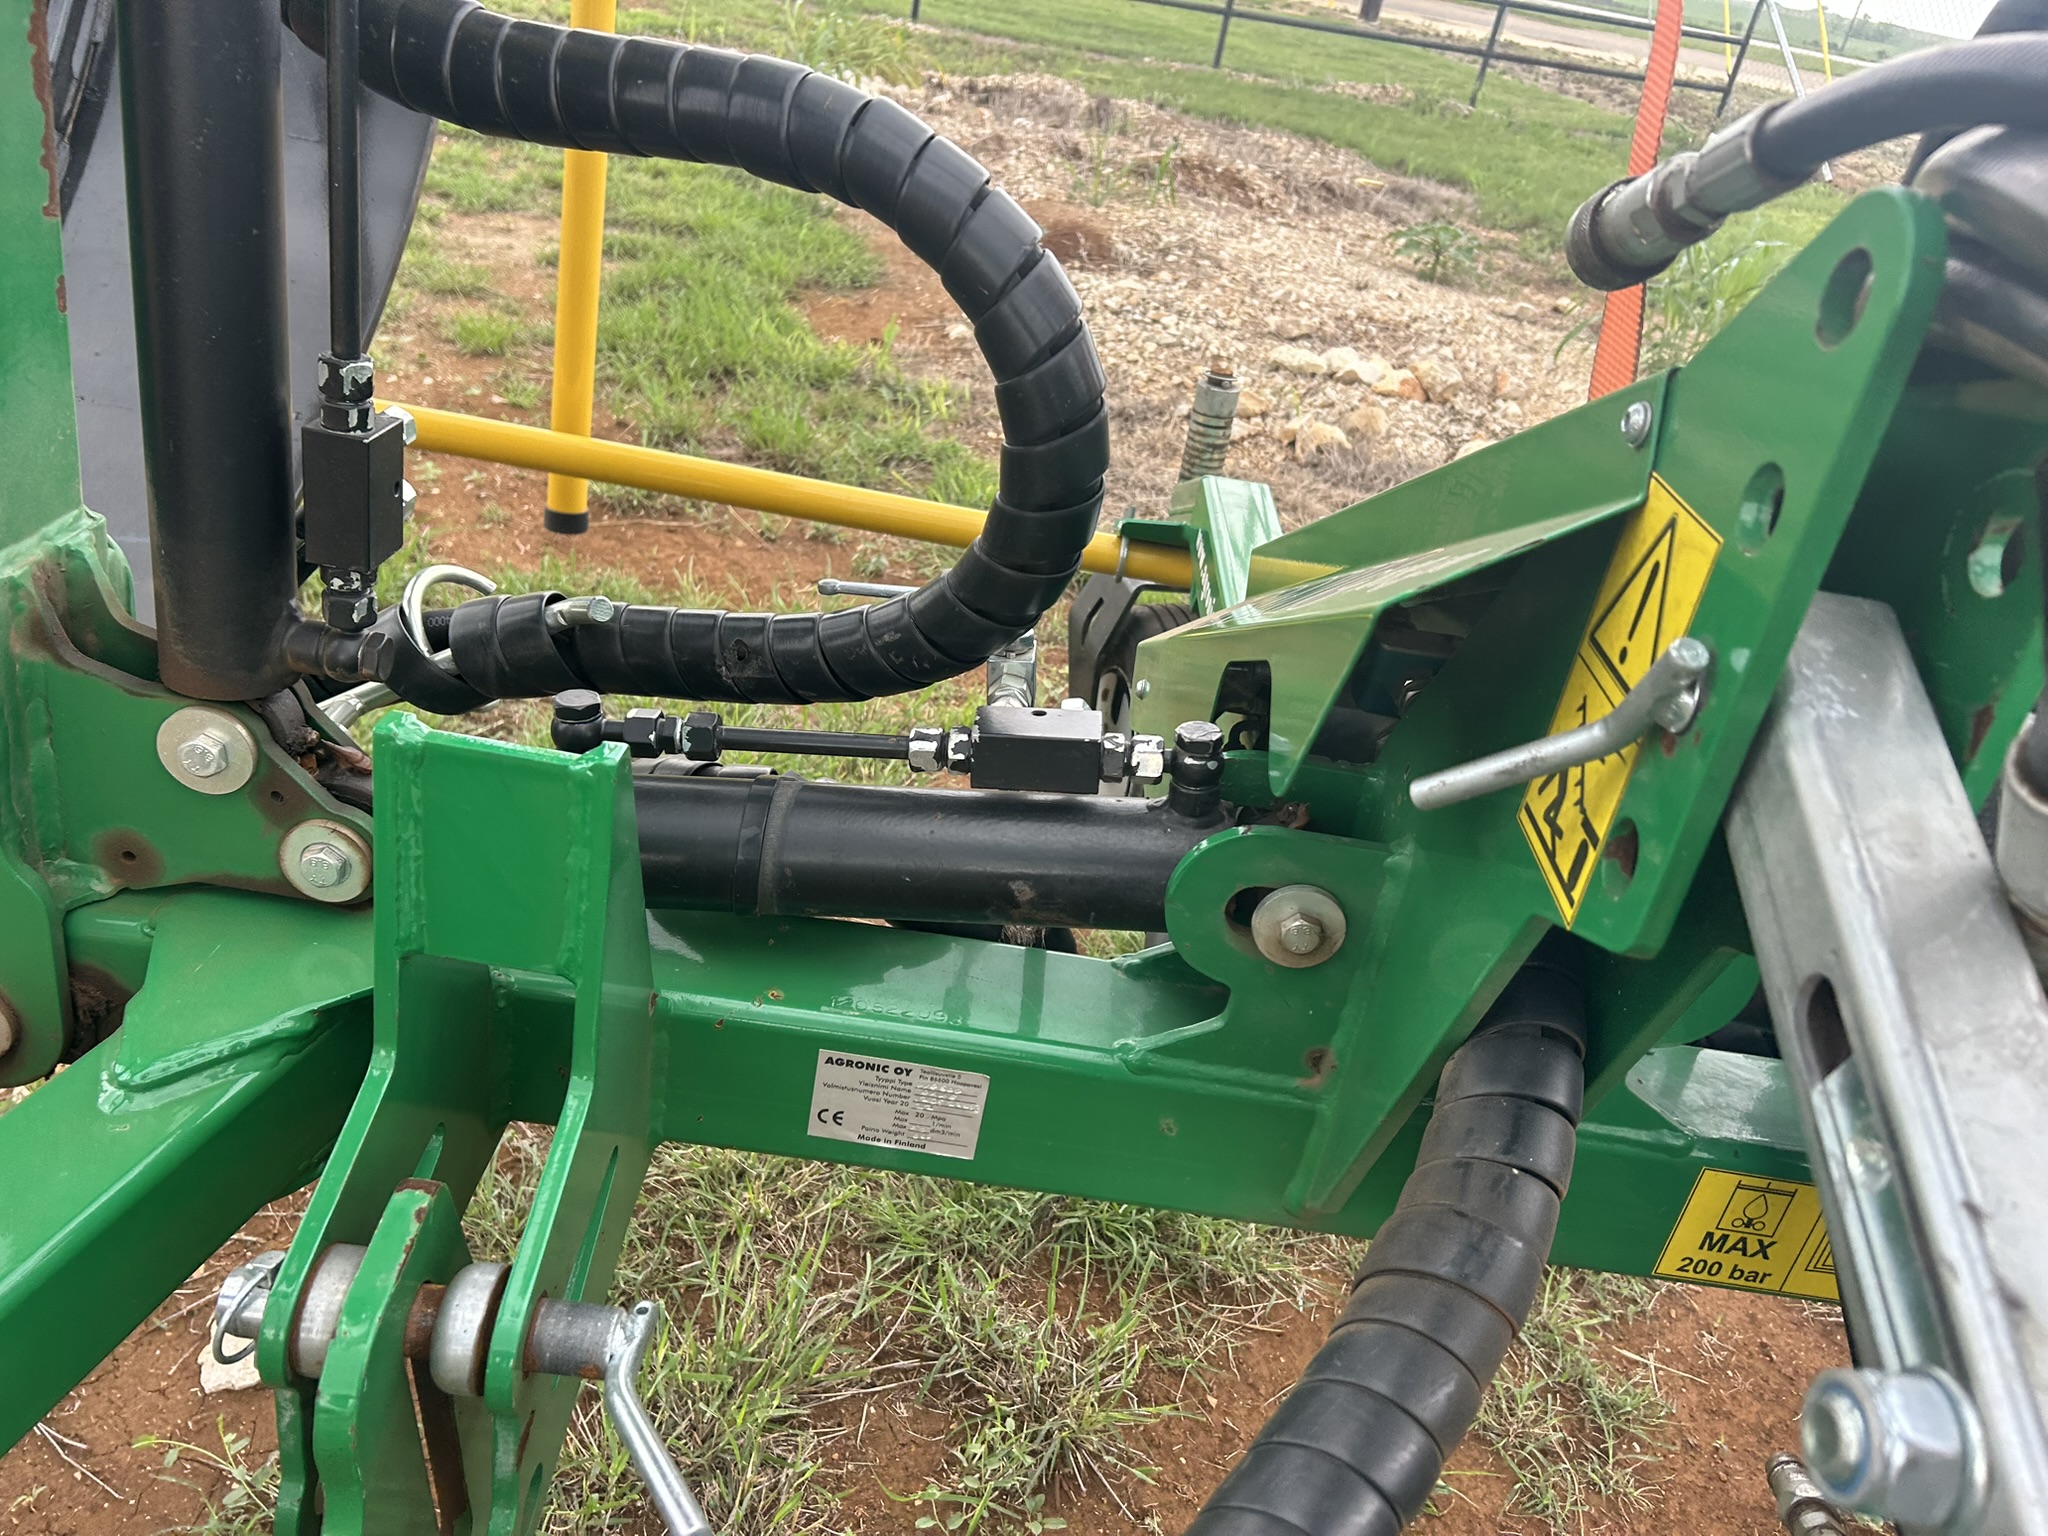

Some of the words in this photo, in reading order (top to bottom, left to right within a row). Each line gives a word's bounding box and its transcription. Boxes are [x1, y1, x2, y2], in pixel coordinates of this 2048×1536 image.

[824, 1056, 890, 1074] AGRONIC
[893, 1066, 914, 1077] OY
[858, 1080, 889, 1090] Yleisnimi
[891, 1085, 912, 1094] Name
[875, 1075, 896, 1085] Tyyppi
[898, 1079, 913, 1087] Type
[822, 1082, 881, 1096] Valmistusnumero
[882, 1090, 911, 1100] Number
[863, 1095, 882, 1103] Vuosi
[817, 1108, 845, 1127] CE
[861, 1125, 880, 1133] Paino
[881, 1128, 906, 1137] Weight
[857, 1133, 882, 1143] Made
[894, 1139, 927, 1150] Finland
[1698, 1231, 1777, 1260] MAX
[1676, 1256, 1723, 1277] 200
[1728, 1264, 1772, 1284] bar
